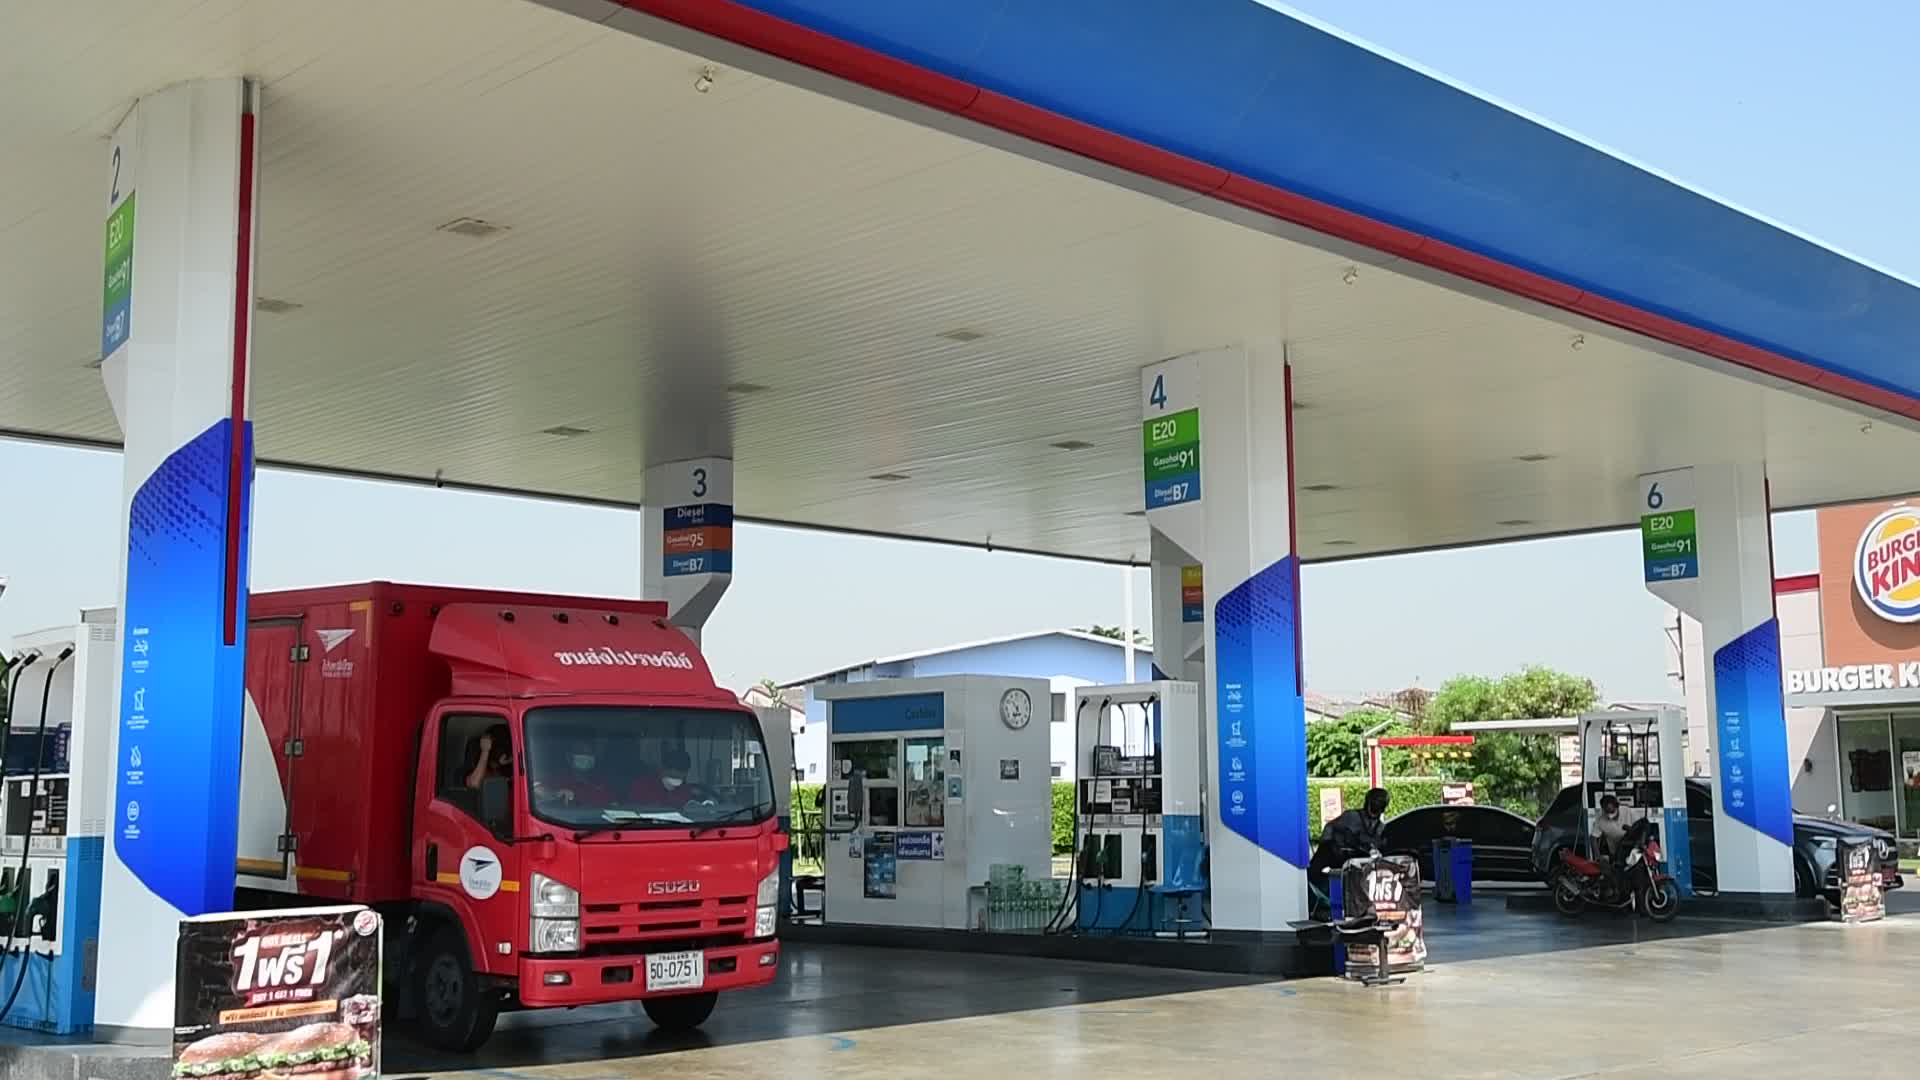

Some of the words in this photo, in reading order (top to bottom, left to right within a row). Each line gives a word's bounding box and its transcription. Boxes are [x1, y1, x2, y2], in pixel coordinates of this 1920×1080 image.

[111, 146, 121, 205] 2
[1150, 374, 1168, 410] 4
[1152, 419, 1177, 441] E20
[1179, 448, 1194, 468] 91
[692, 468, 708, 498] 3
[1173, 482, 1189, 501] B7
[1648, 482, 1663, 509] 6
[677, 505, 705, 519] Diesel
[1650, 516, 1674, 531] E20
[689, 533, 704, 548] 95
[1676, 538, 1691, 553] 91
[1868, 530, 1920, 572] BURG
[689, 557, 704, 572] B7
[1671, 563, 1686, 577] B7
[1872, 550, 1920, 598] KIN
[1788, 663, 1894, 694] BURGER
[647, 879, 700, 894] ISUZU
[650, 959, 698, 979] 50-0751
